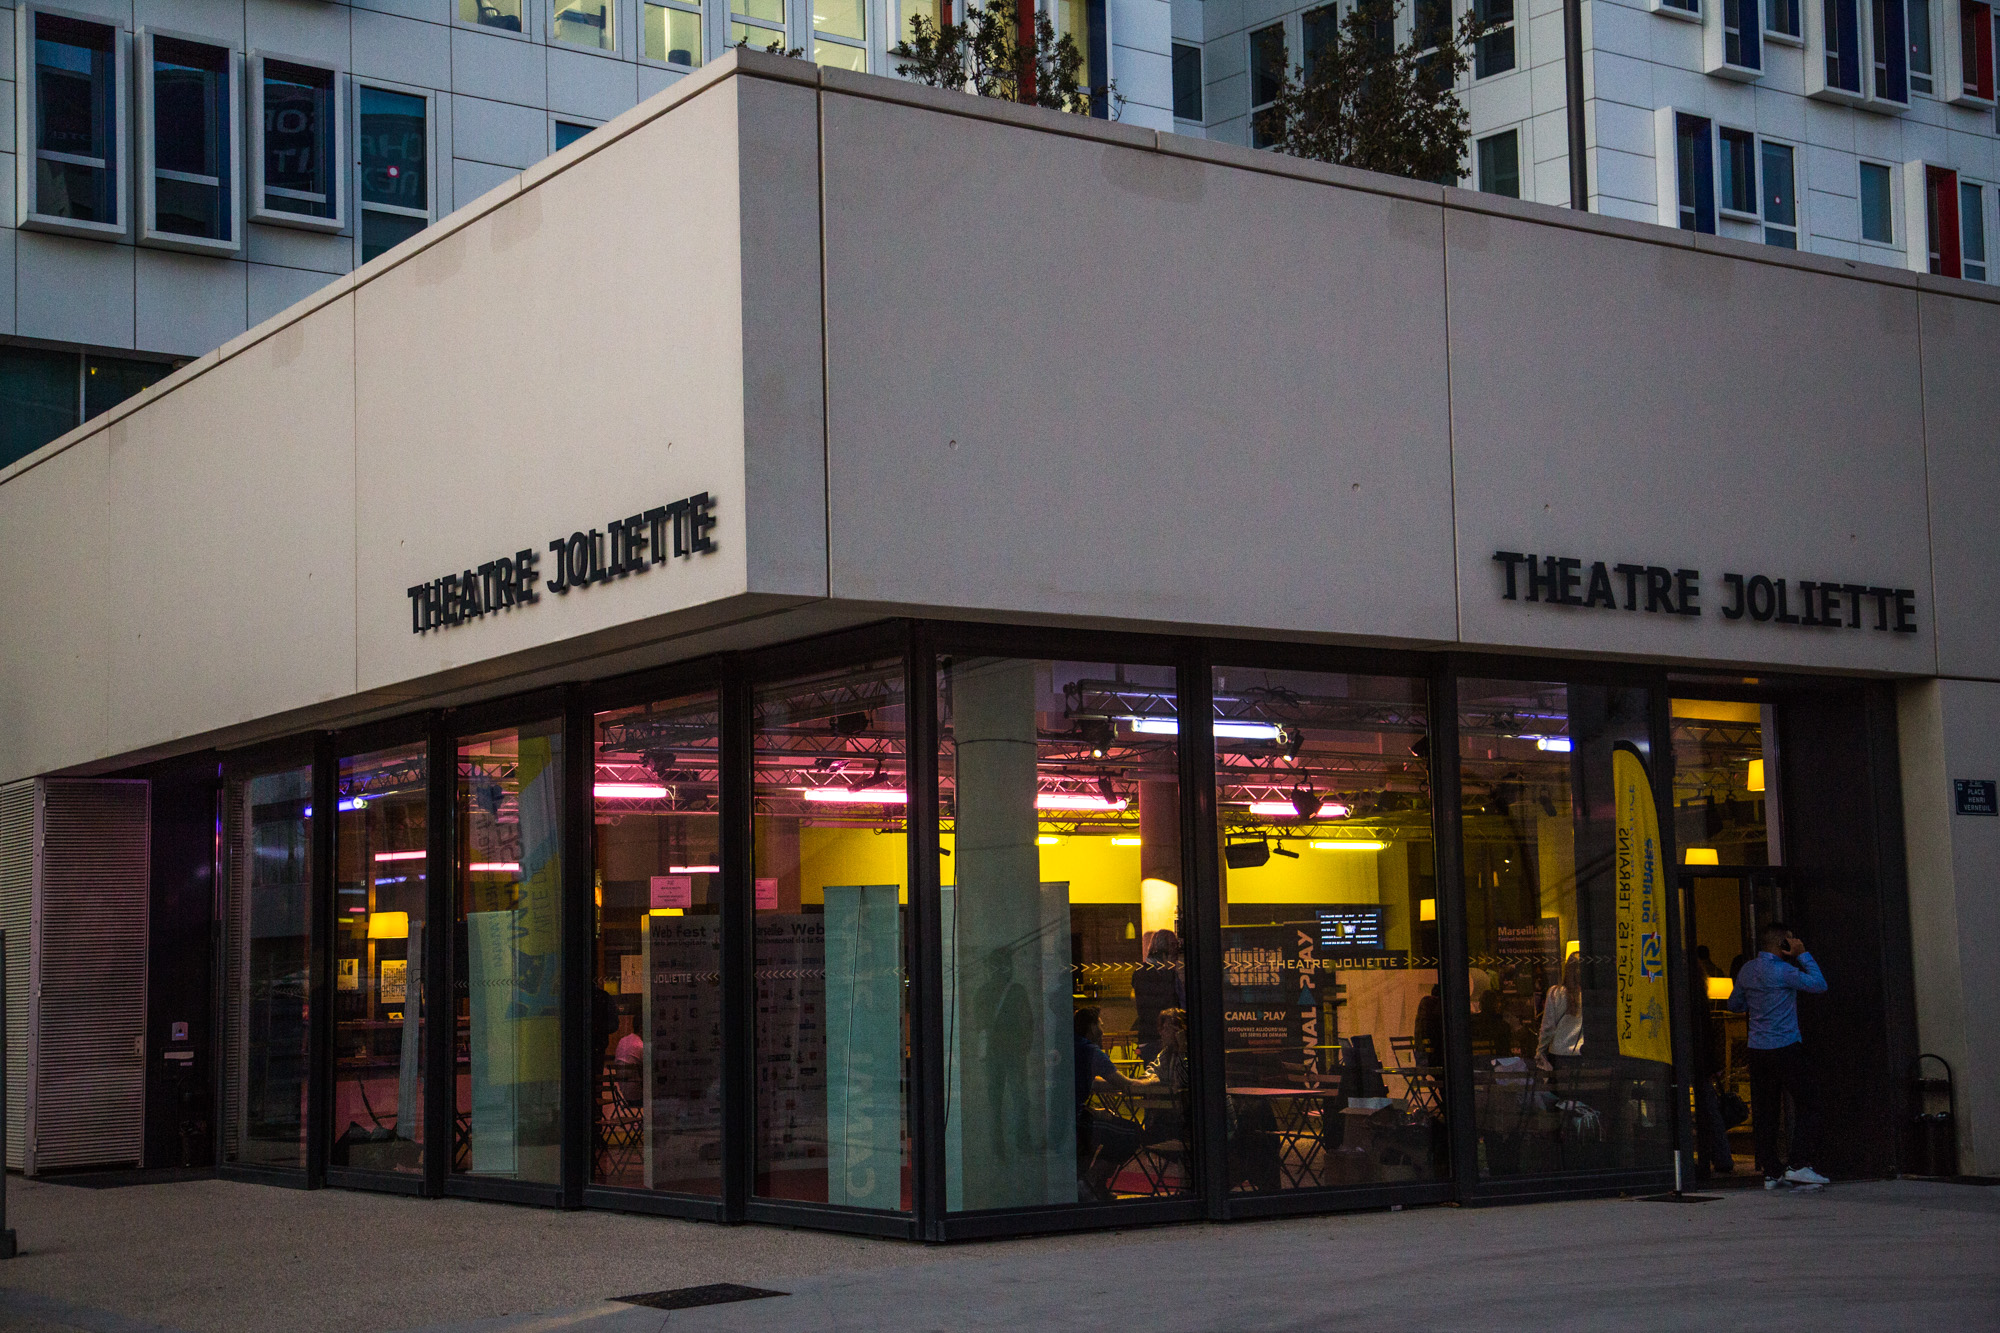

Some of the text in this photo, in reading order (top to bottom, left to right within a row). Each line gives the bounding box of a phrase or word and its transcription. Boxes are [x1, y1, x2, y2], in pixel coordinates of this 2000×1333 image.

[407, 491, 714, 634] THEATRE JOLIETTE
[1493, 551, 1918, 633] THEATRE JOLIETTE
[652, 923, 706, 938] Web Fest
[791, 923, 824, 936] Web
[1268, 957, 1398, 970] THEATRE JOLIETTE
[1297, 929, 1316, 989] PLAY
[654, 973, 693, 984] JOLIETTE
[1224, 1011, 1286, 1021] CANAL PLAY
